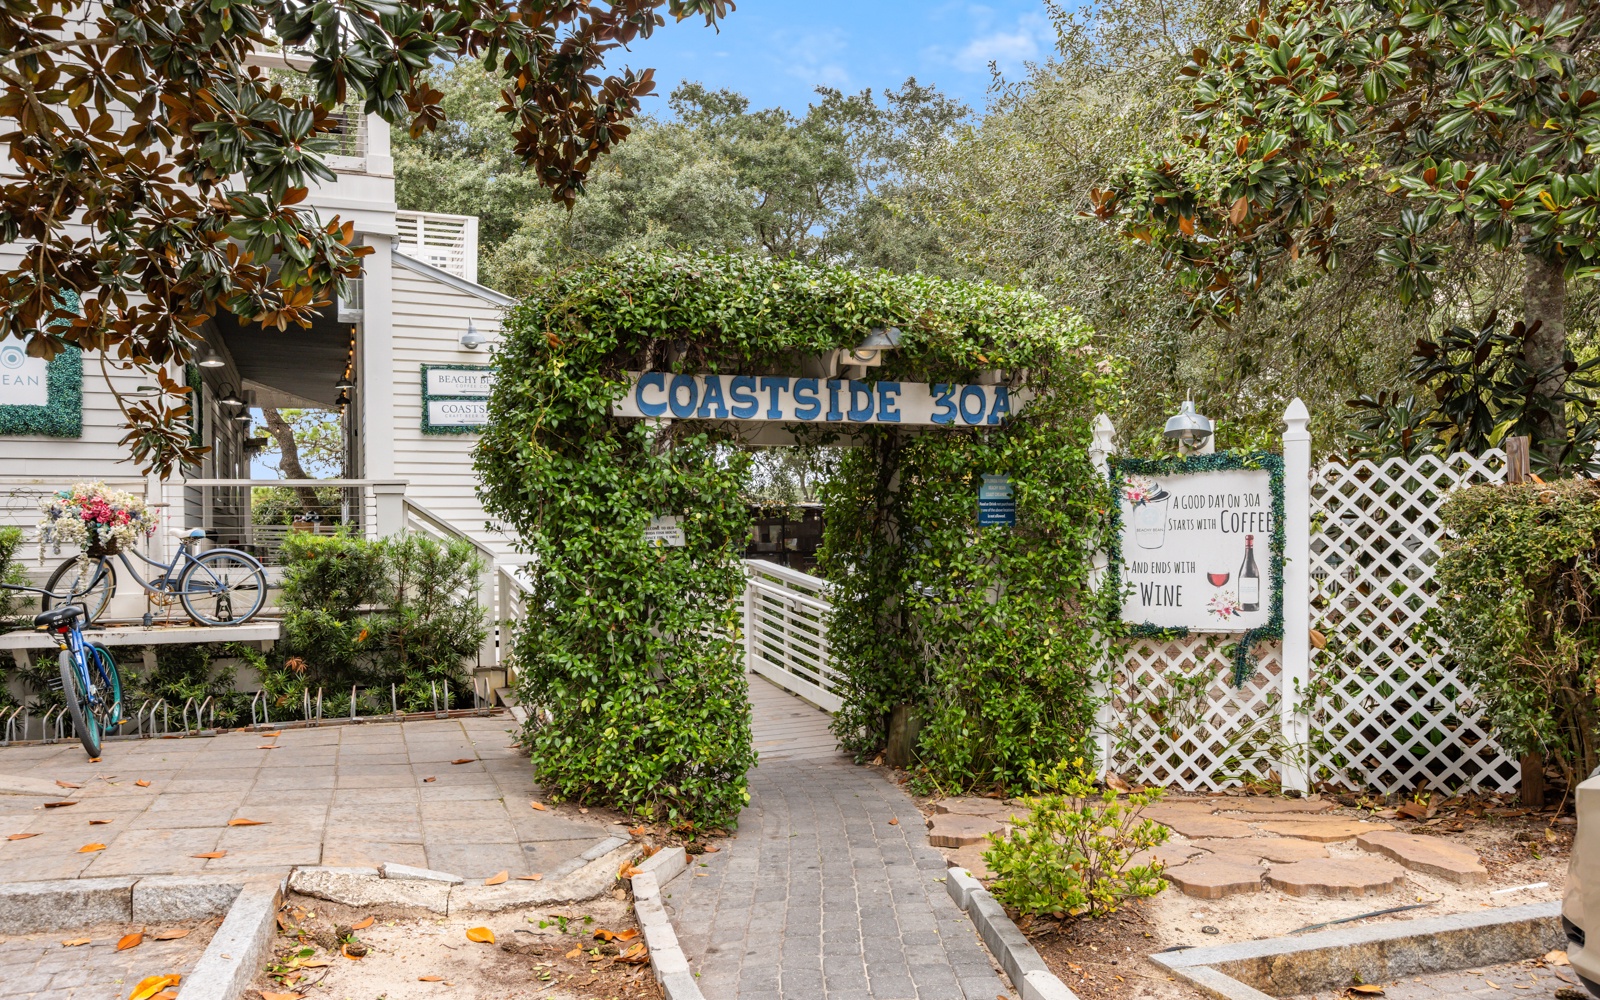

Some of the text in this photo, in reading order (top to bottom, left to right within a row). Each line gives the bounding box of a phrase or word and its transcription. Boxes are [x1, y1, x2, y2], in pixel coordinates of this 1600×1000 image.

[2, 374, 39, 386] EAN
[438, 375, 478, 384] BEACHY
[635, 372, 1010, 425] COASTSIDE 30A
[1172, 495, 1179, 510] A
[1181, 495, 1206, 510] GOOD
[1208, 494, 1226, 509] DAY
[1243, 493, 1261, 508] 30A
[1168, 509, 1273, 534] STARTS WITH COFFEE
[1131, 560, 1196, 574] AND ENDS WITH
[1140, 581, 1183, 607] WINE
